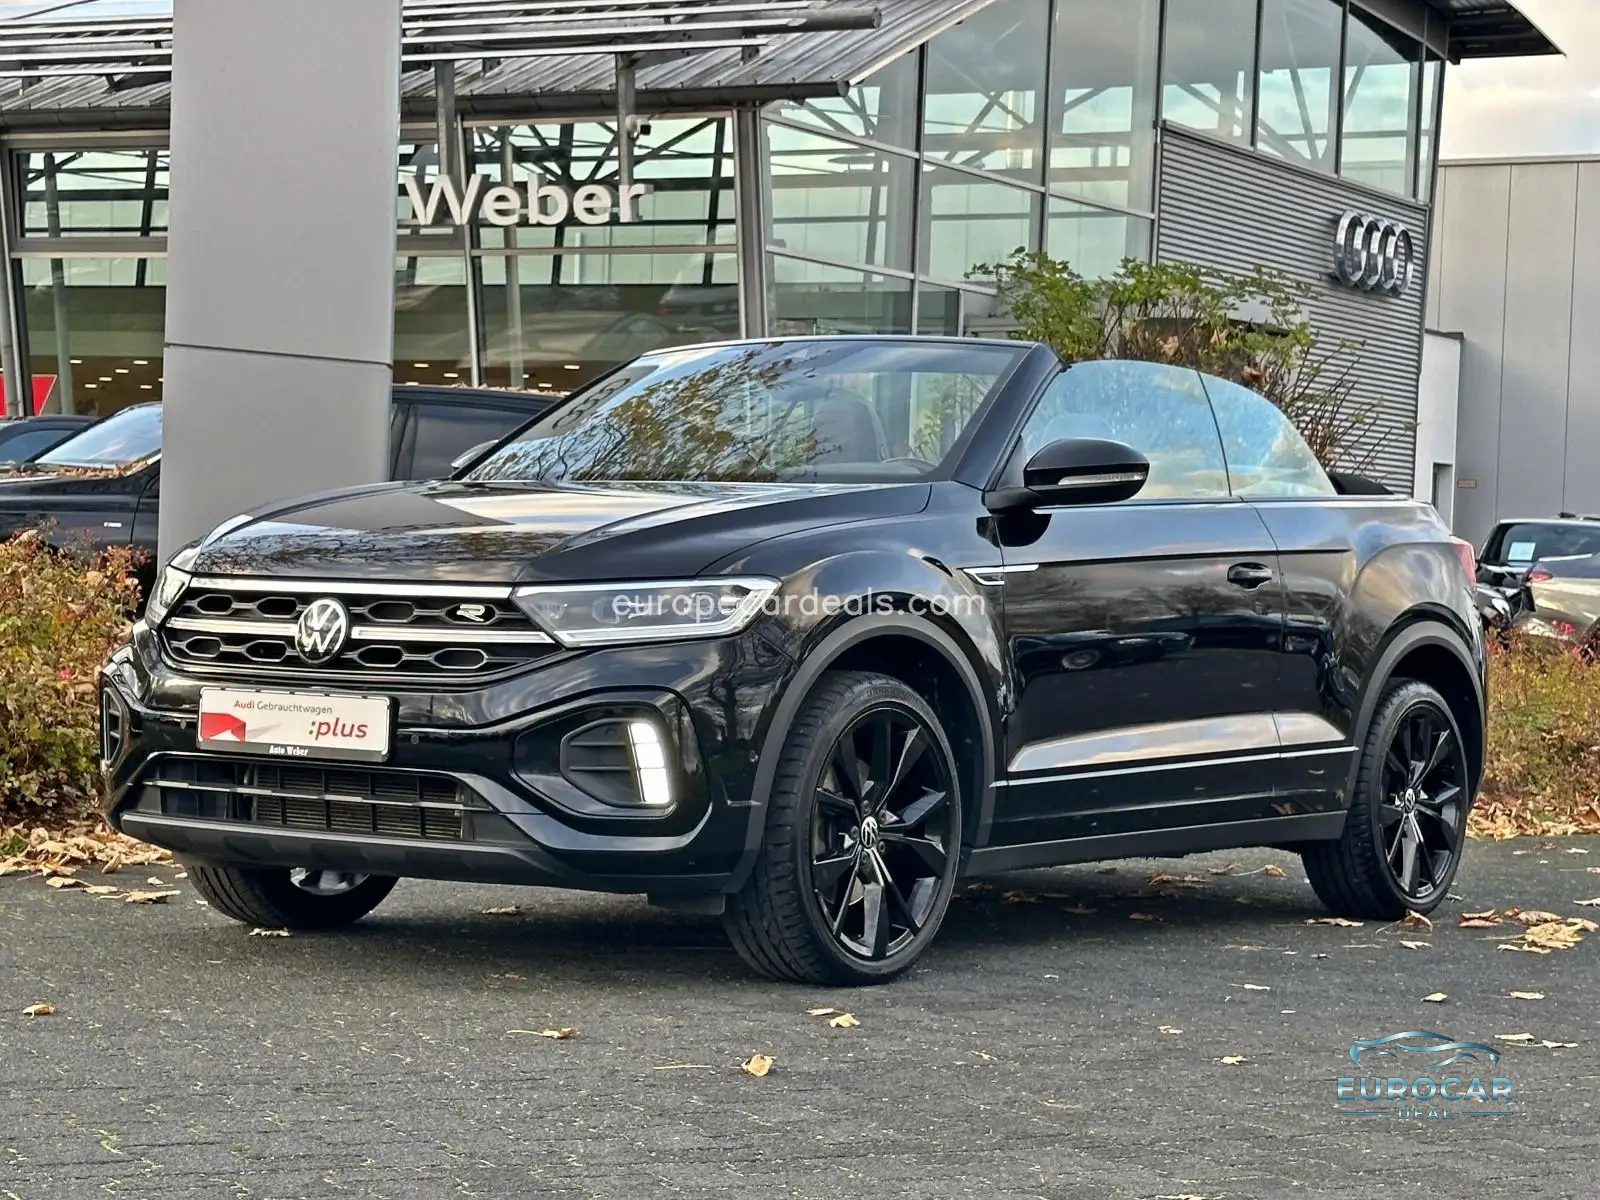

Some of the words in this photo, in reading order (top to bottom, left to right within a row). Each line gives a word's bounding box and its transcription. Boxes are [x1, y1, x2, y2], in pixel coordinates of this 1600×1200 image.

[403, 173, 650, 226] Weber
[234, 700, 255, 710] Audi
[256, 701, 333, 716] Gebrauchtwagen
[309, 717, 369, 741] :plus
